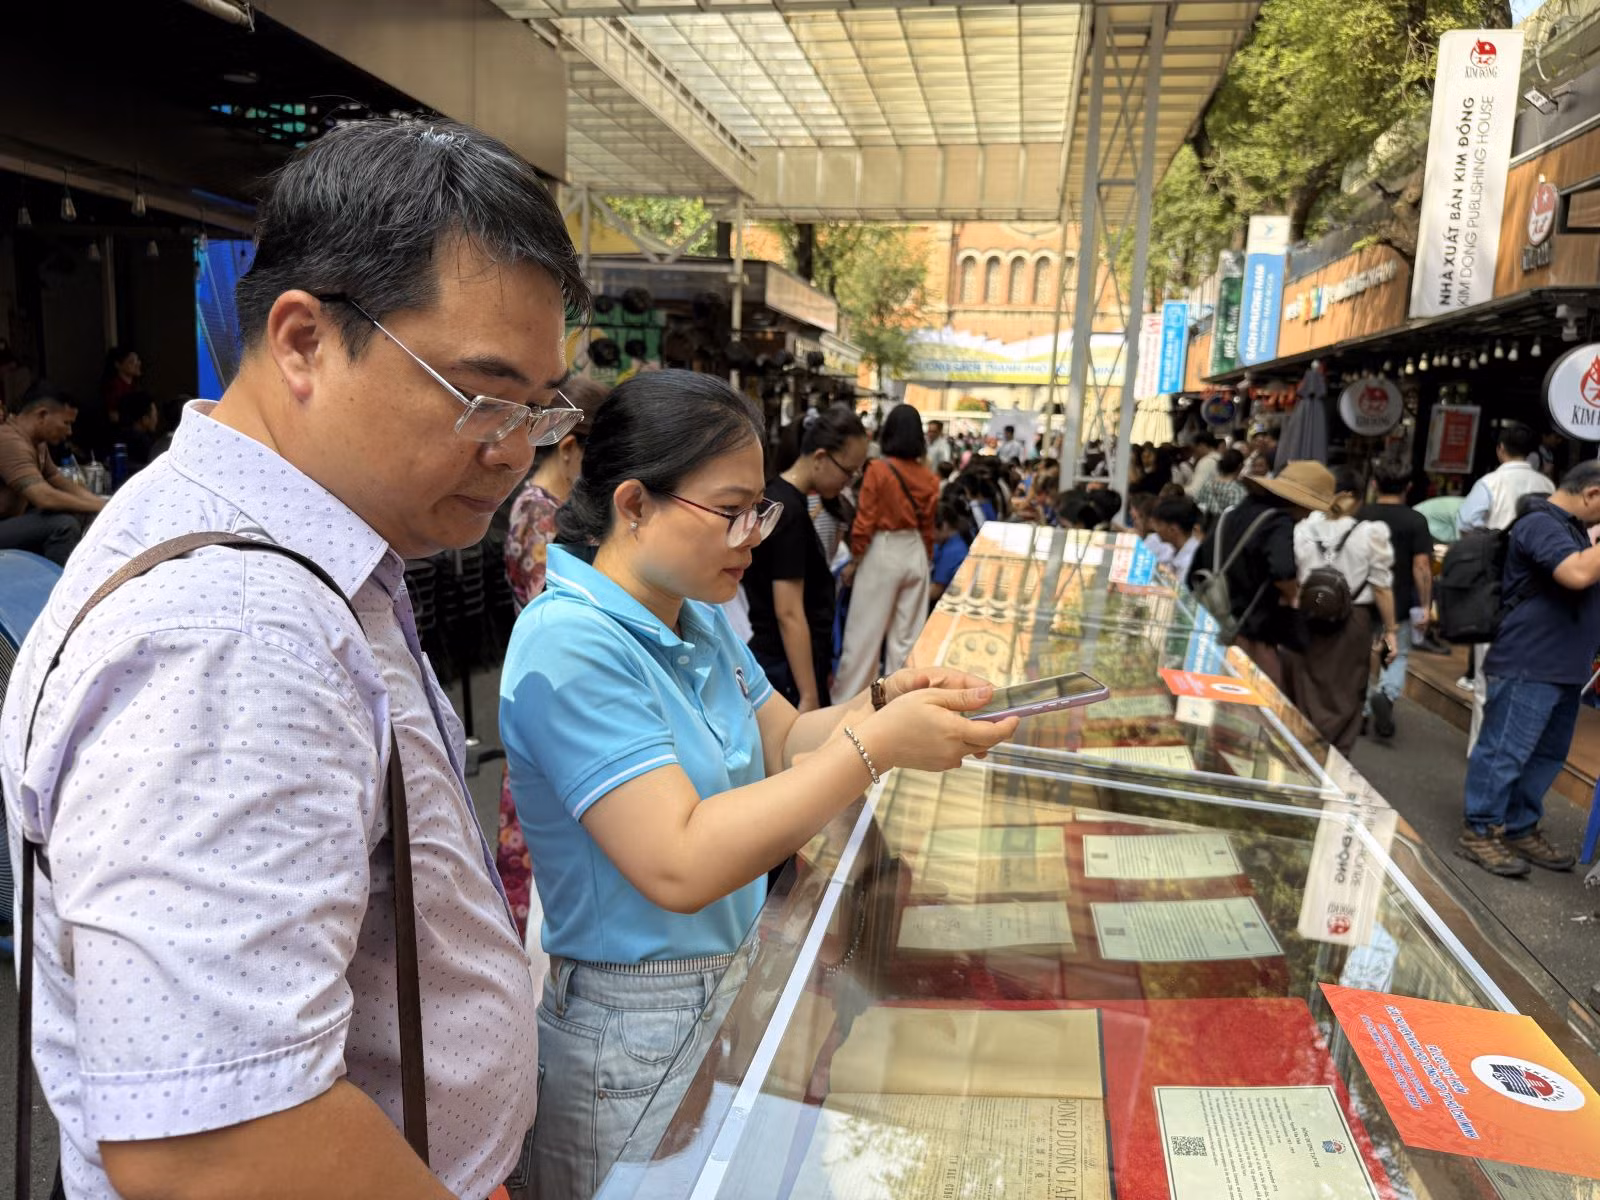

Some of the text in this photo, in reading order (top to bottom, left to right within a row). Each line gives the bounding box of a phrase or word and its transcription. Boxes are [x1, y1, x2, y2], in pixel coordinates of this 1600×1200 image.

[1436, 97, 1475, 306] NHÀ XUẤT BẢN KIM ĐỒNG
[1457, 96, 1494, 307] KIM DONG PUBLISHING HOUSE
[1253, 264, 1265, 289] NAM
[1571, 405, 1594, 425] KIM
[1055, 1132, 1078, 1176] DƯƠNG
